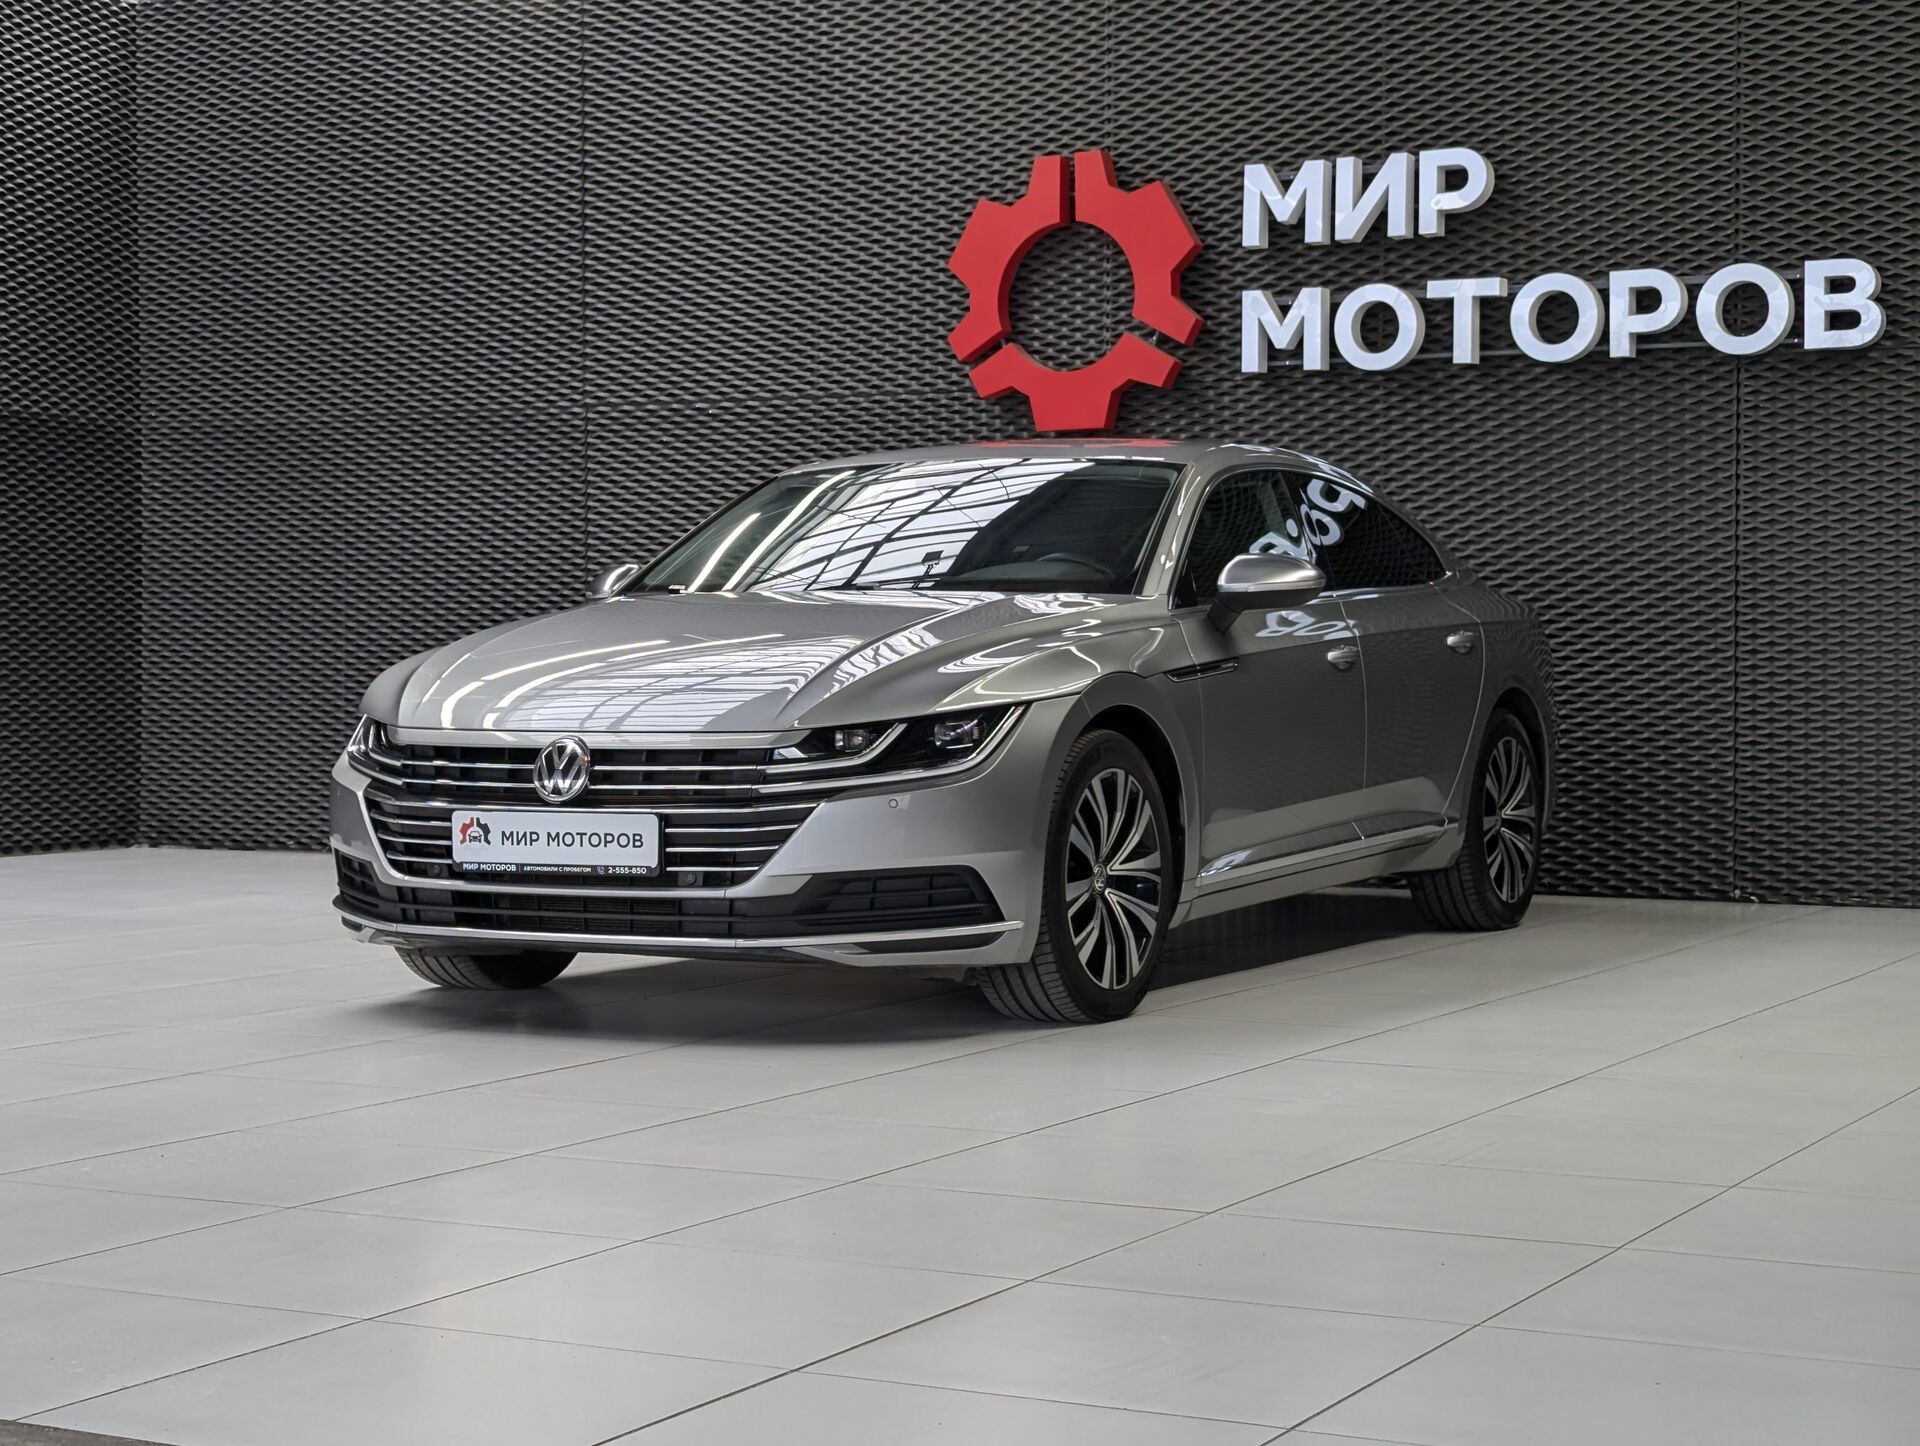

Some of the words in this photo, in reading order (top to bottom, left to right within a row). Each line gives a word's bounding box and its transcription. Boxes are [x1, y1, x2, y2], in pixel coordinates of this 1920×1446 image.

[1242, 147, 1495, 249] МИР
[1241, 258, 1887, 374] МОТОРОВ
[463, 863, 479, 871] МИР
[480, 864, 517, 872] МОТОРОВ
[608, 867, 647, 875] 2-555-850
[501, 831, 540, 847] МИР
[547, 832, 644, 849] МОТОРОВ
